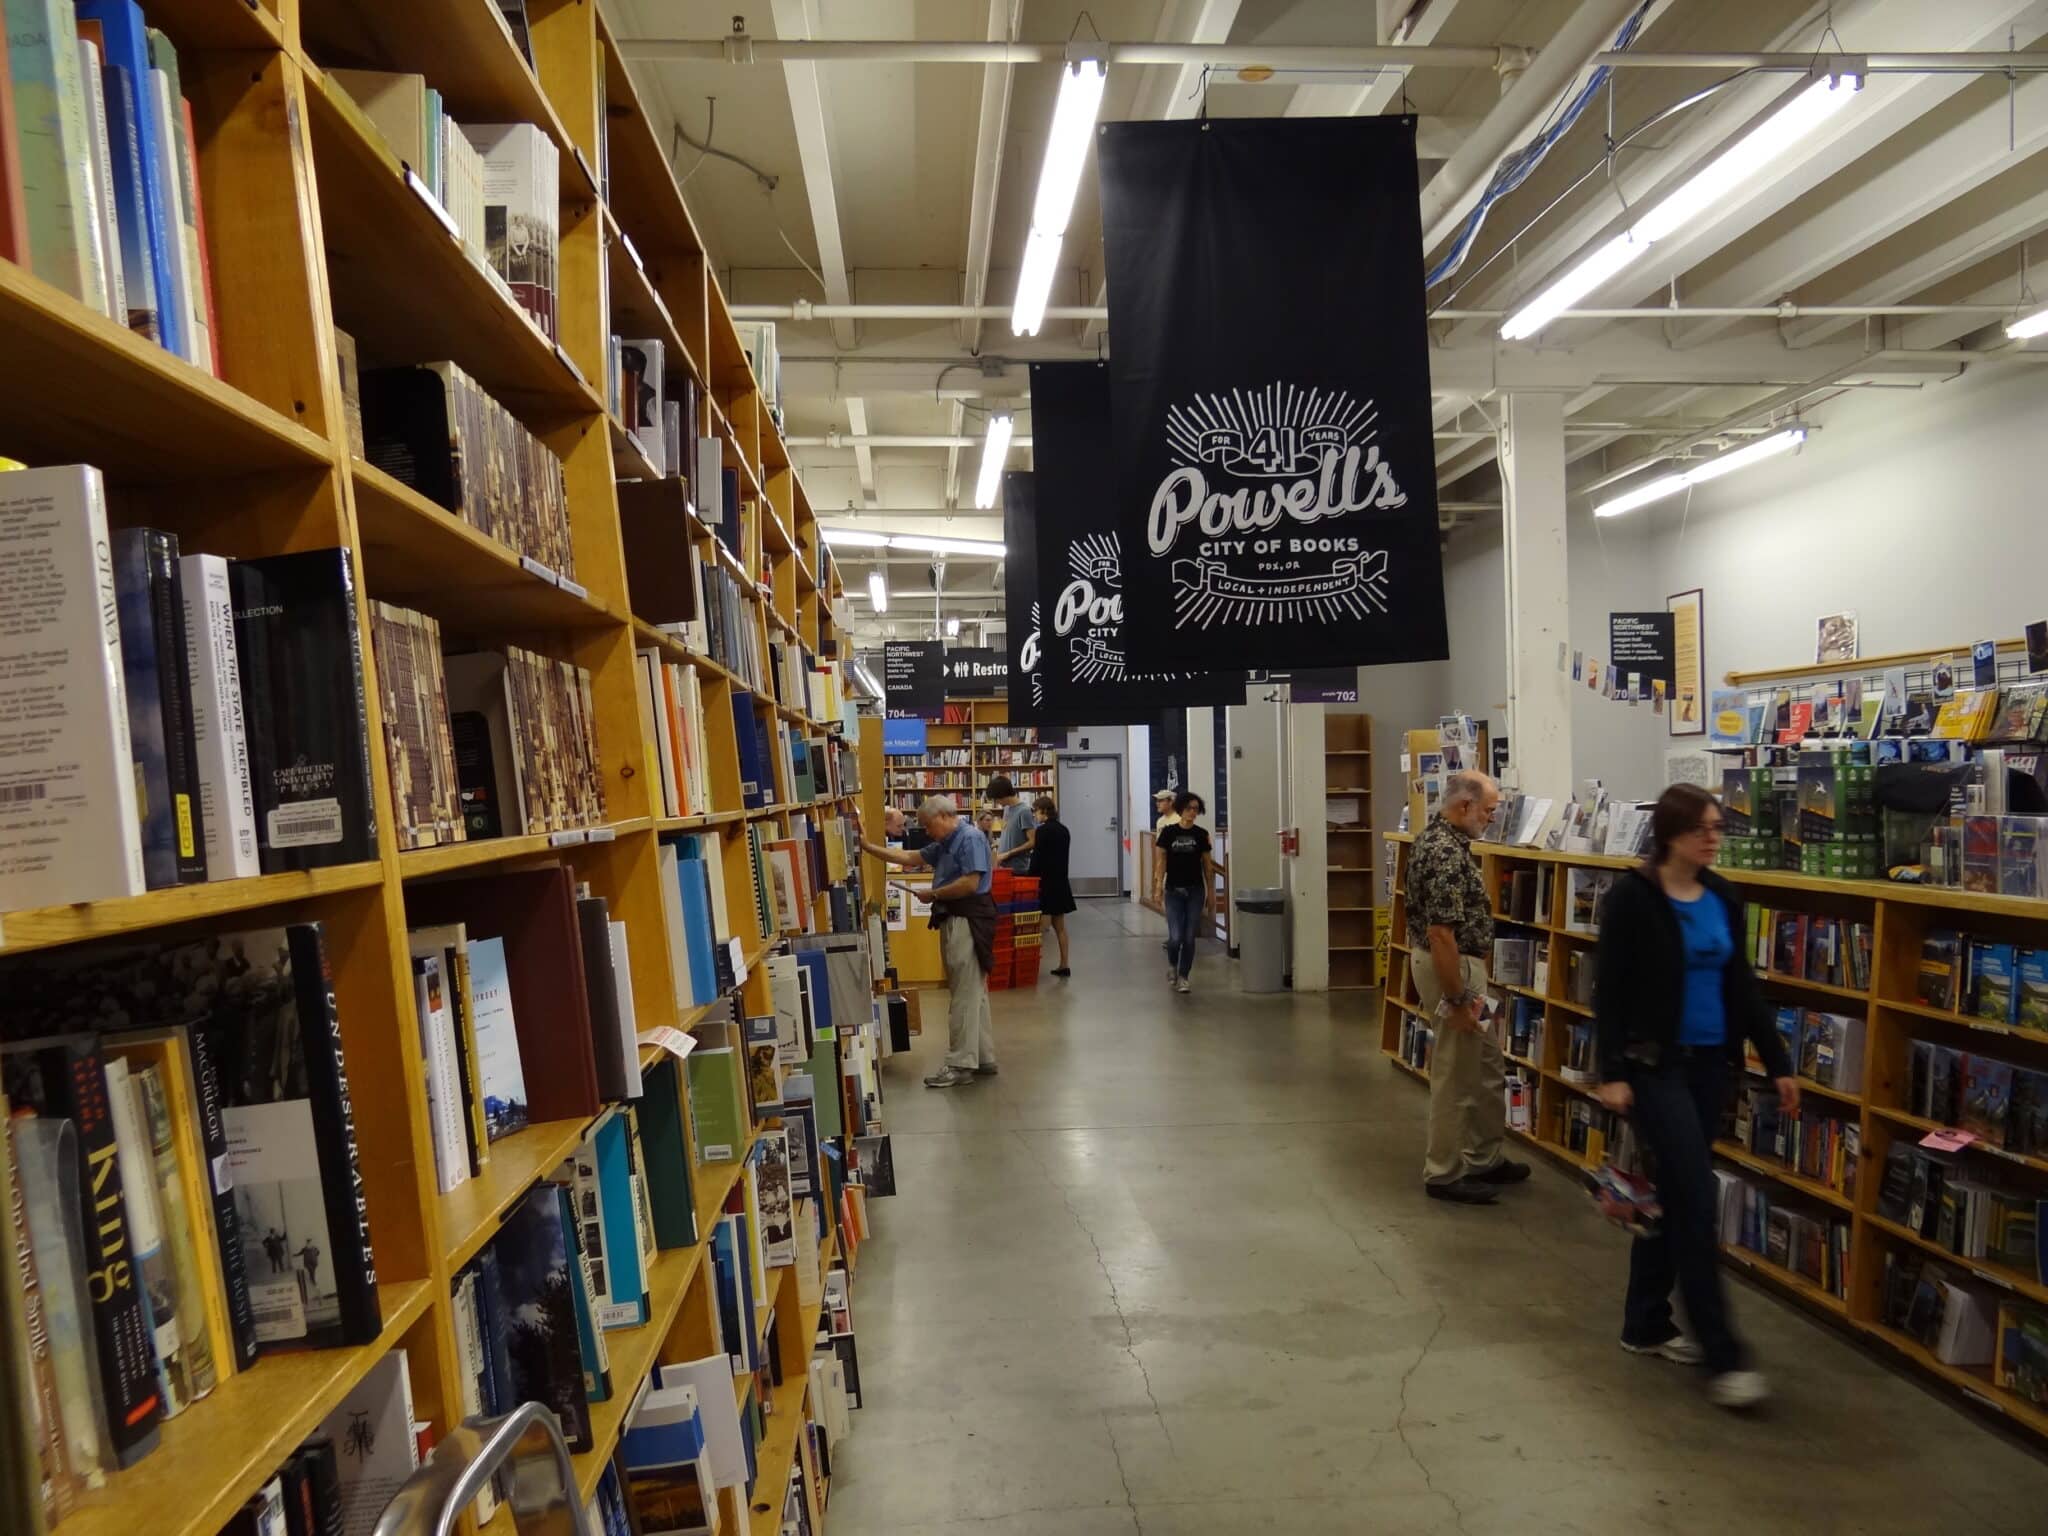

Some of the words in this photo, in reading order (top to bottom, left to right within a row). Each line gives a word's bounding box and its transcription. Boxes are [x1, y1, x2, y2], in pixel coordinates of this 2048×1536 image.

[1212, 435, 1231, 446] FOR
[1249, 427, 1296, 473] 41
[1307, 430, 1340, 442] YEARS
[1148, 446, 1408, 557] Powell's
[1199, 541, 1245, 556] CITY
[1254, 540, 1281, 554] OF
[1290, 538, 1359, 552] BOOKS
[95, 540, 120, 646] OTTAWA
[1218, 579, 1255, 594] LOCAL
[1268, 577, 1350, 595] INDEPENDENT
[221, 603, 234, 650] WHEN
[1088, 627, 1118, 637] CITY
[227, 657, 239, 686] THE
[1100, 651, 1123, 662] LOCAL
[230, 690, 243, 732] STATE
[1336, 691, 1356, 701] 702
[888, 710, 905, 718] 704
[235, 740, 253, 817] TREMBLED
[178, 800, 192, 850] USED
[327, 991, 377, 1286] UNDESIRABLES
[86, 1142, 131, 1303] King
